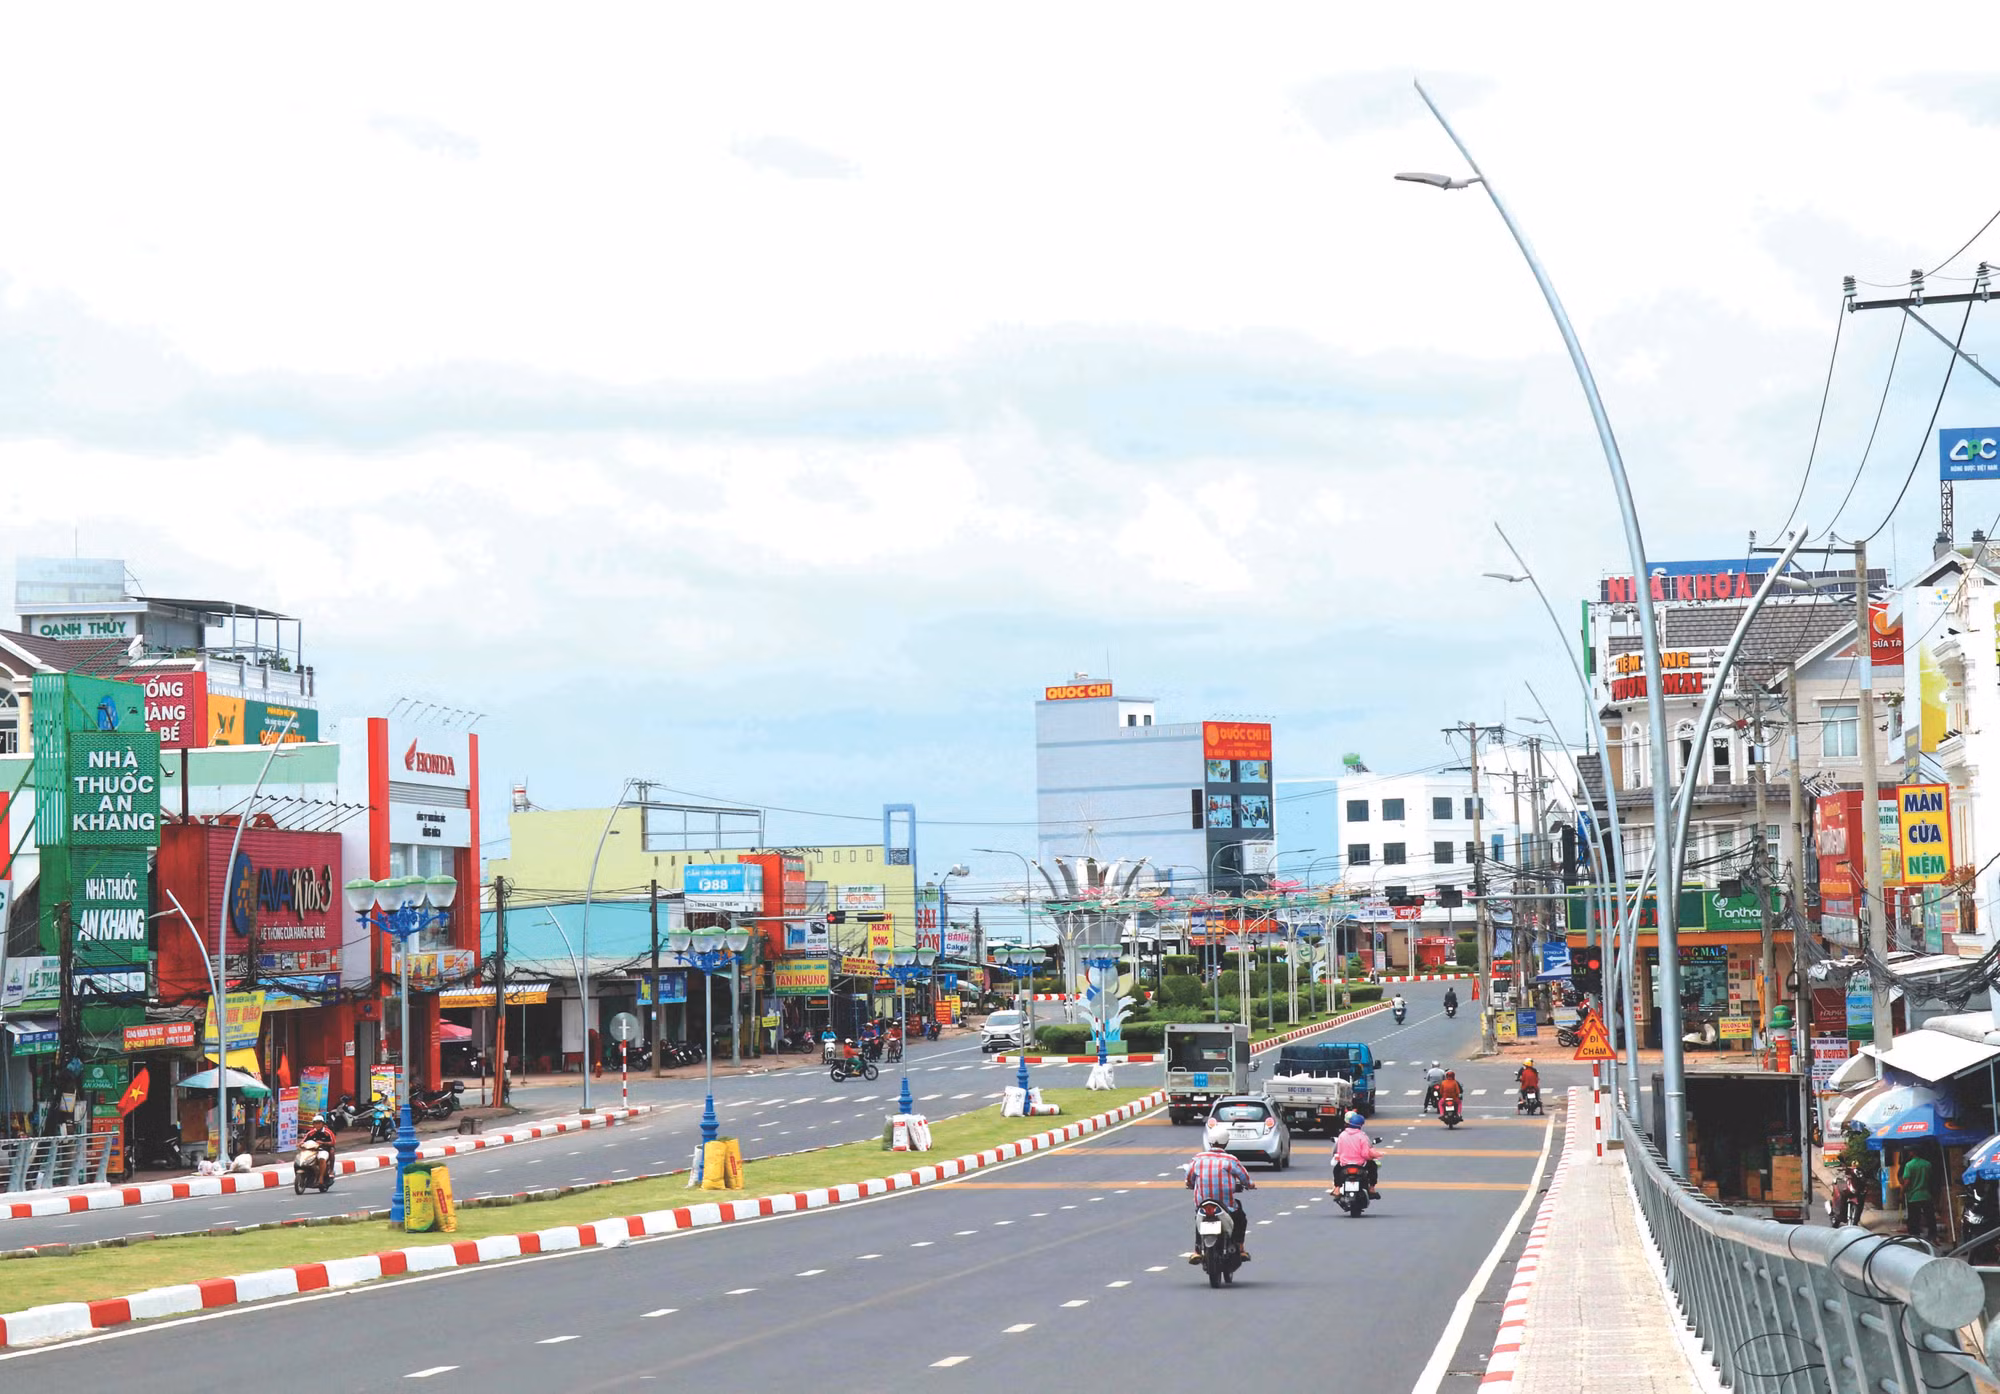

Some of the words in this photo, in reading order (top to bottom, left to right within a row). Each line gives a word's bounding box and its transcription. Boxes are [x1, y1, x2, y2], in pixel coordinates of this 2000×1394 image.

[40, 623, 81, 636] OANH
[87, 618, 126, 635] THỦY
[1660, 651, 1690, 669] NG
[143, 675, 184, 698] ỐNG
[1662, 672, 1703, 695] MAI
[160, 721, 180, 742] BÉ
[88, 745, 139, 768] NHÀ
[416, 752, 455, 776] HONDA
[73, 769, 154, 794] THUỐC
[98, 795, 132, 812] AN
[73, 812, 155, 831] KHANG
[1908, 820, 1942, 843] CỬA
[86, 873, 106, 900] NHÀ
[106, 872, 137, 900] THUỐC
[77, 909, 99, 942] AN
[99, 908, 145, 941] KHANG
[795, 974, 826, 985] NHUNG
